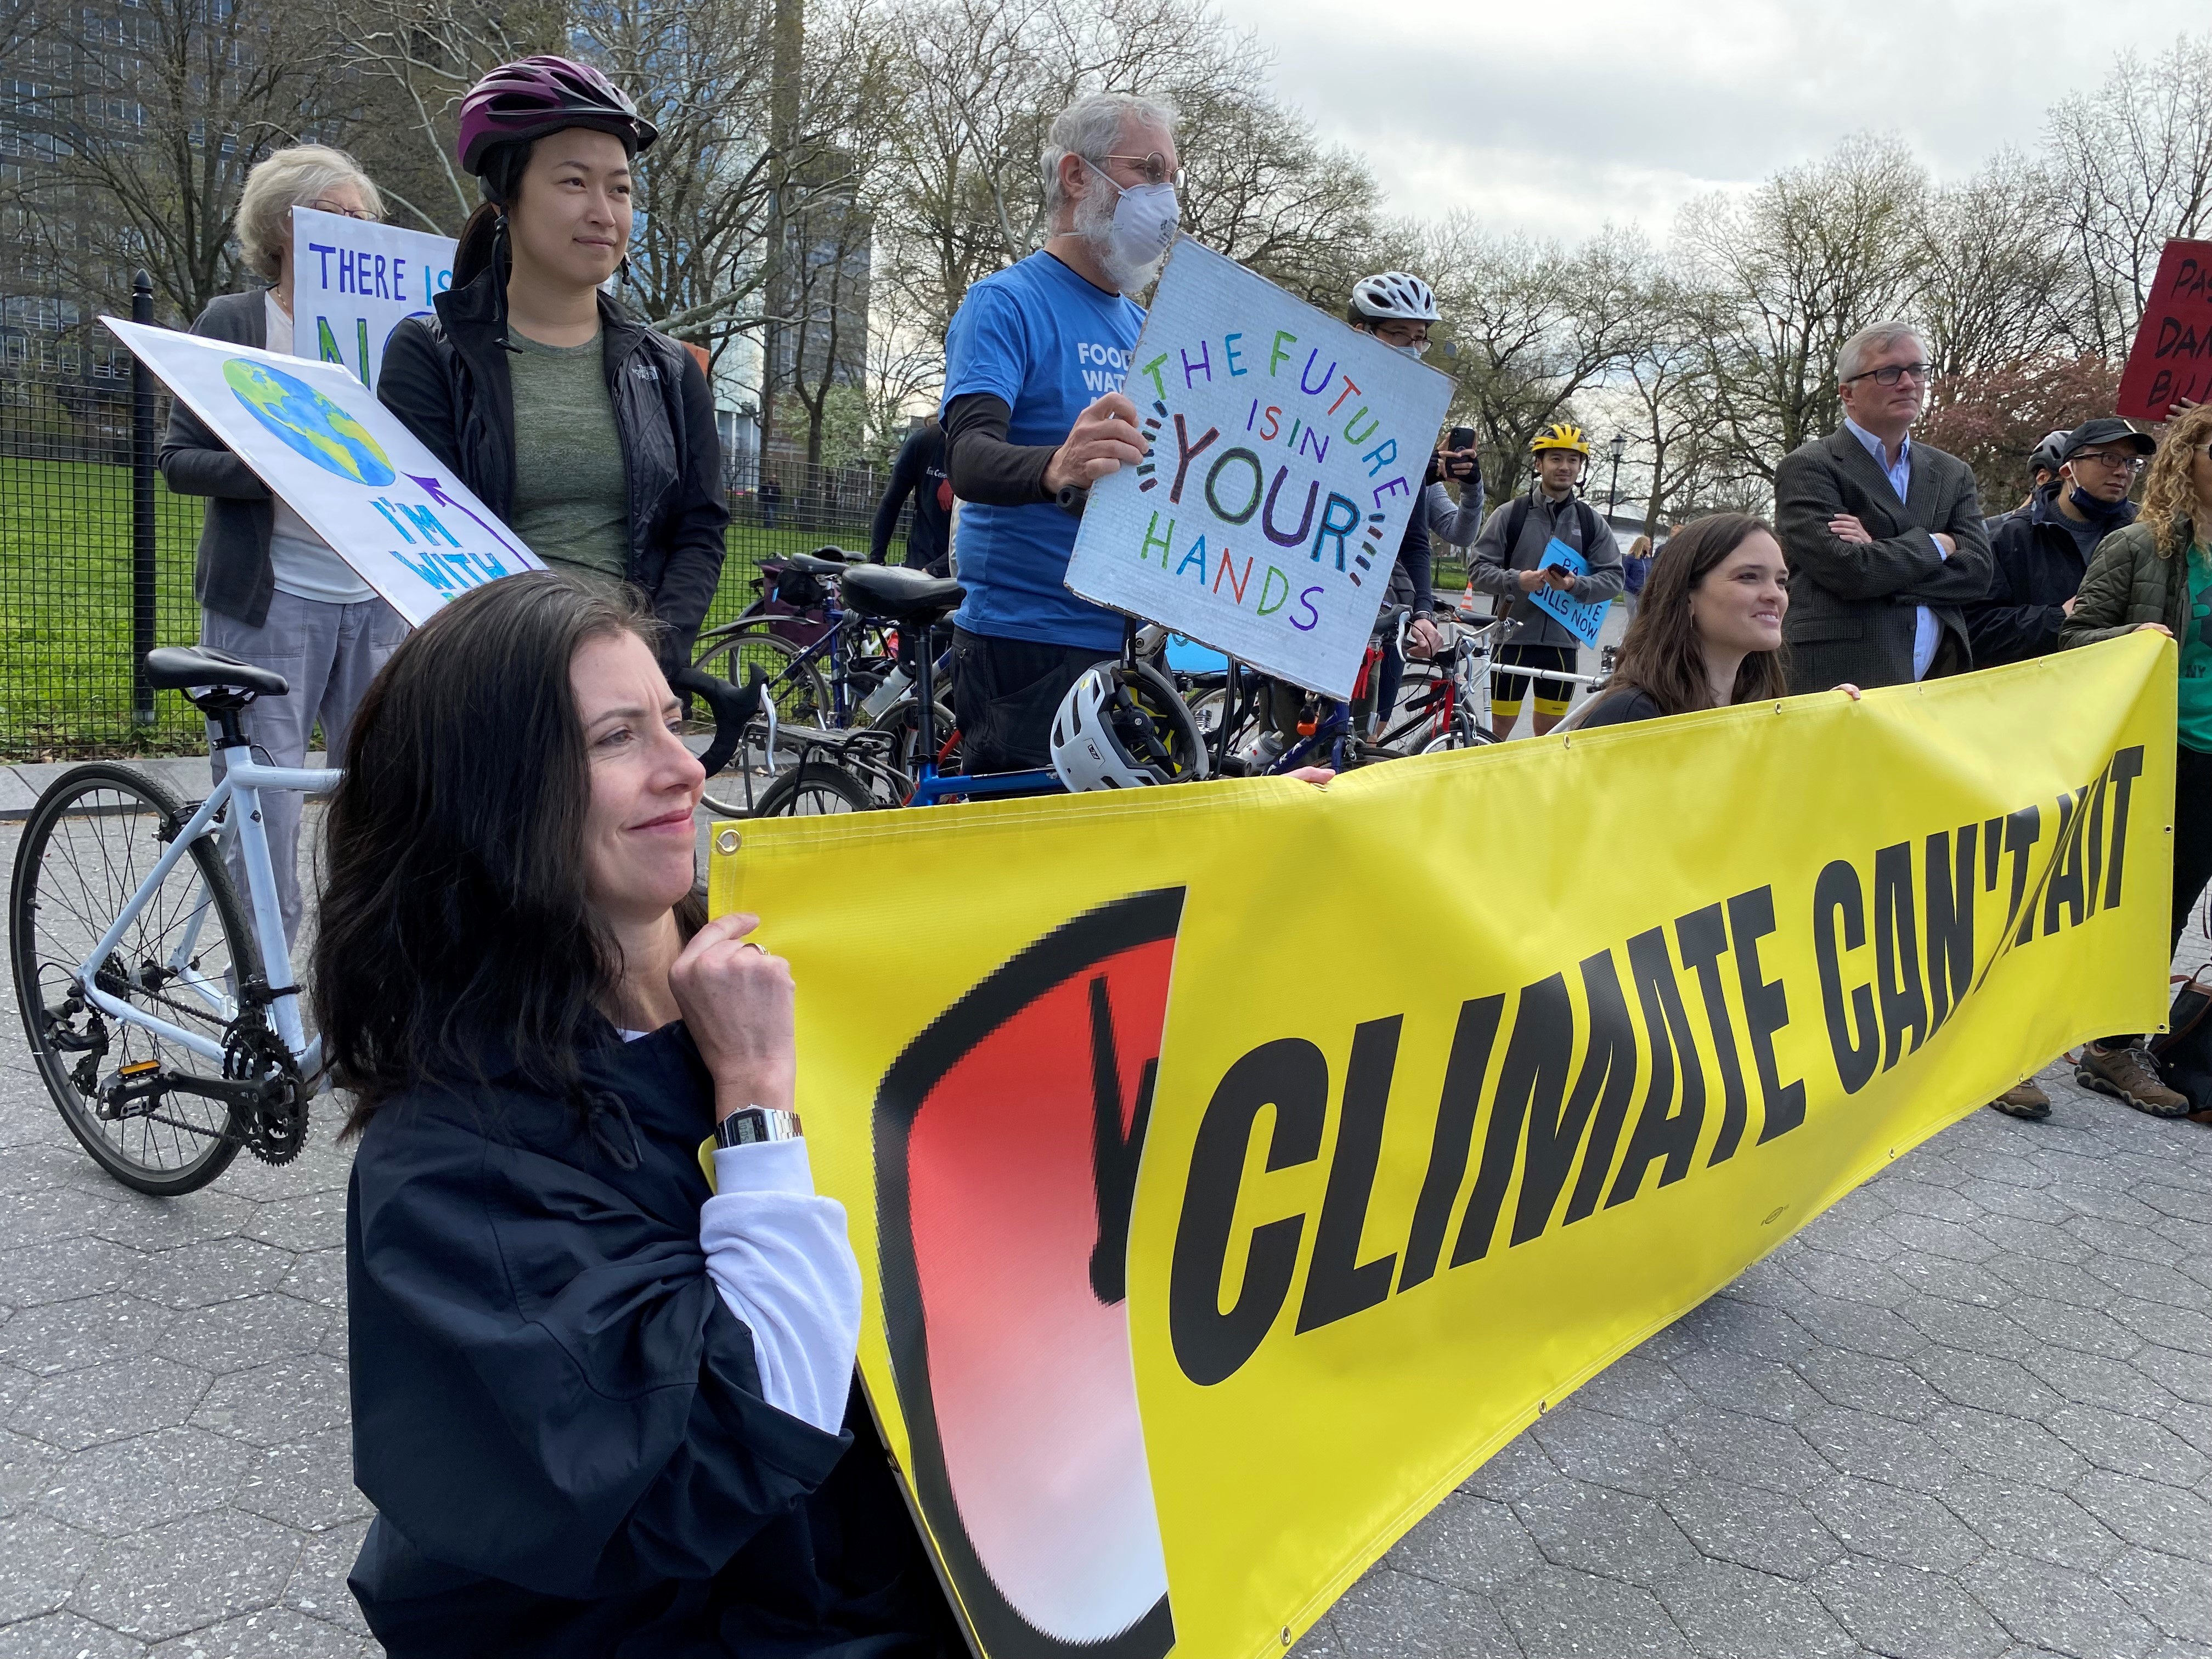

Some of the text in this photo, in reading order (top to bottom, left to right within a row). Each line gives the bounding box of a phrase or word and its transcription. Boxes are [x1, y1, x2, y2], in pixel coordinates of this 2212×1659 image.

[309, 242, 406, 301] THERE
[1081, 369, 1125, 395] WAT
[1142, 330, 1410, 509] THE FUTURE
[1246, 398, 1330, 464] IS IN
[369, 496, 464, 548] I'M
[1170, 414, 1361, 573] YOUR
[388, 550, 510, 590] WITH
[1140, 511, 1324, 631] HANDS
[1564, 558, 1579, 576] PA
[1571, 609, 1598, 641] NOW
[1170, 885, 1807, 1386] CLIMATE
[1813, 804, 2040, 1095] CAN'T
